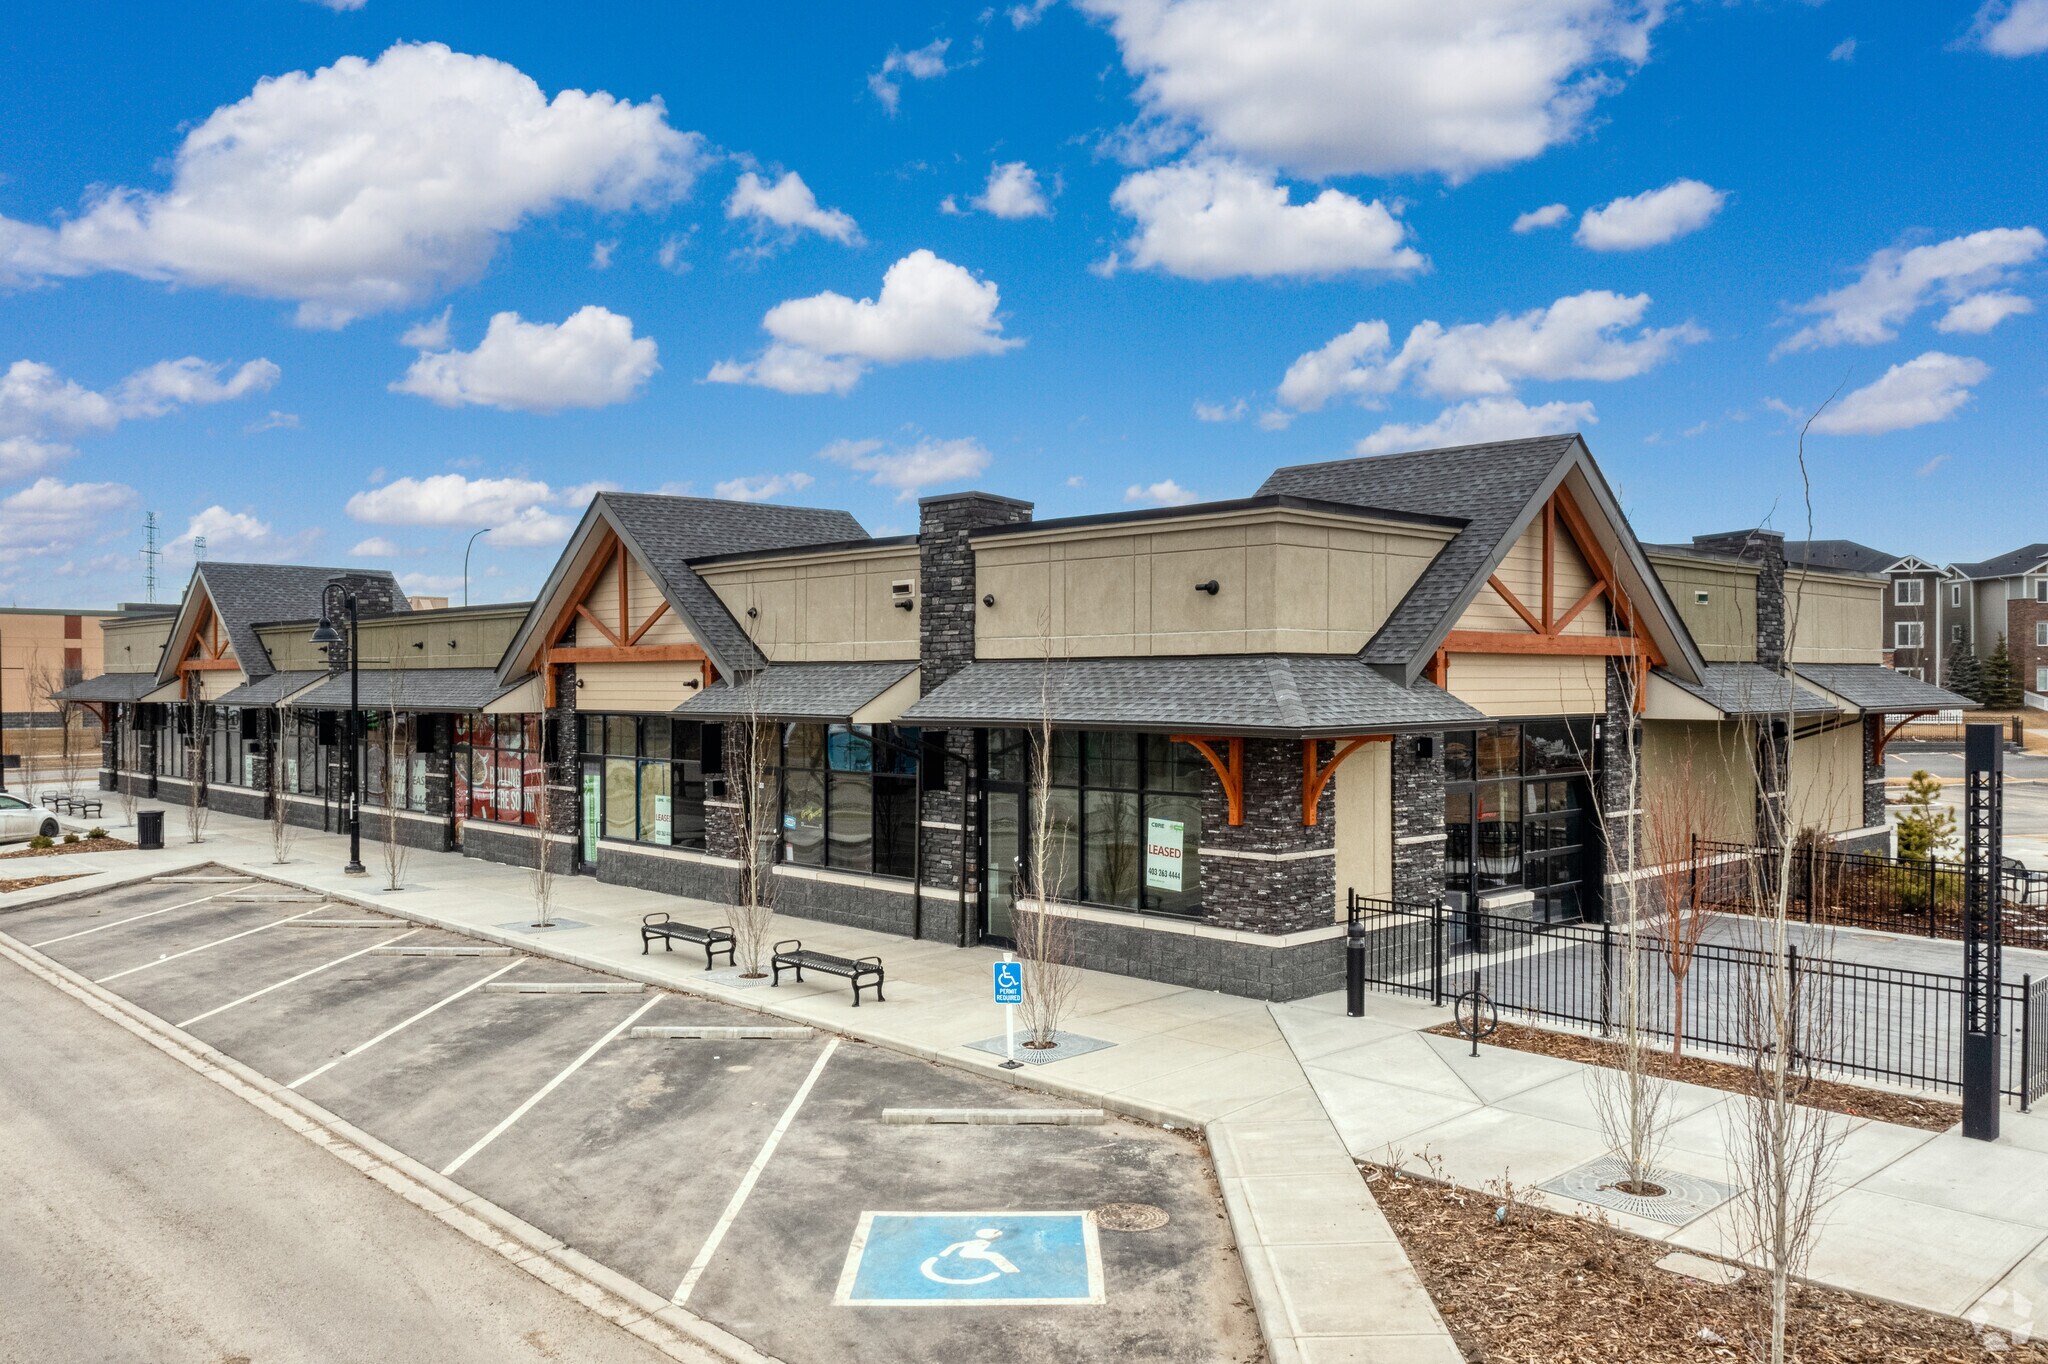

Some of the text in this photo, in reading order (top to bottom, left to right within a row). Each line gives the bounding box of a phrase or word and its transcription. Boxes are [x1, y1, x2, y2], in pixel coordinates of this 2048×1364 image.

[1148, 844, 1181, 859] LEASED
[1148, 867, 1158, 876] 403
[1168, 870, 1181, 880] 4444
